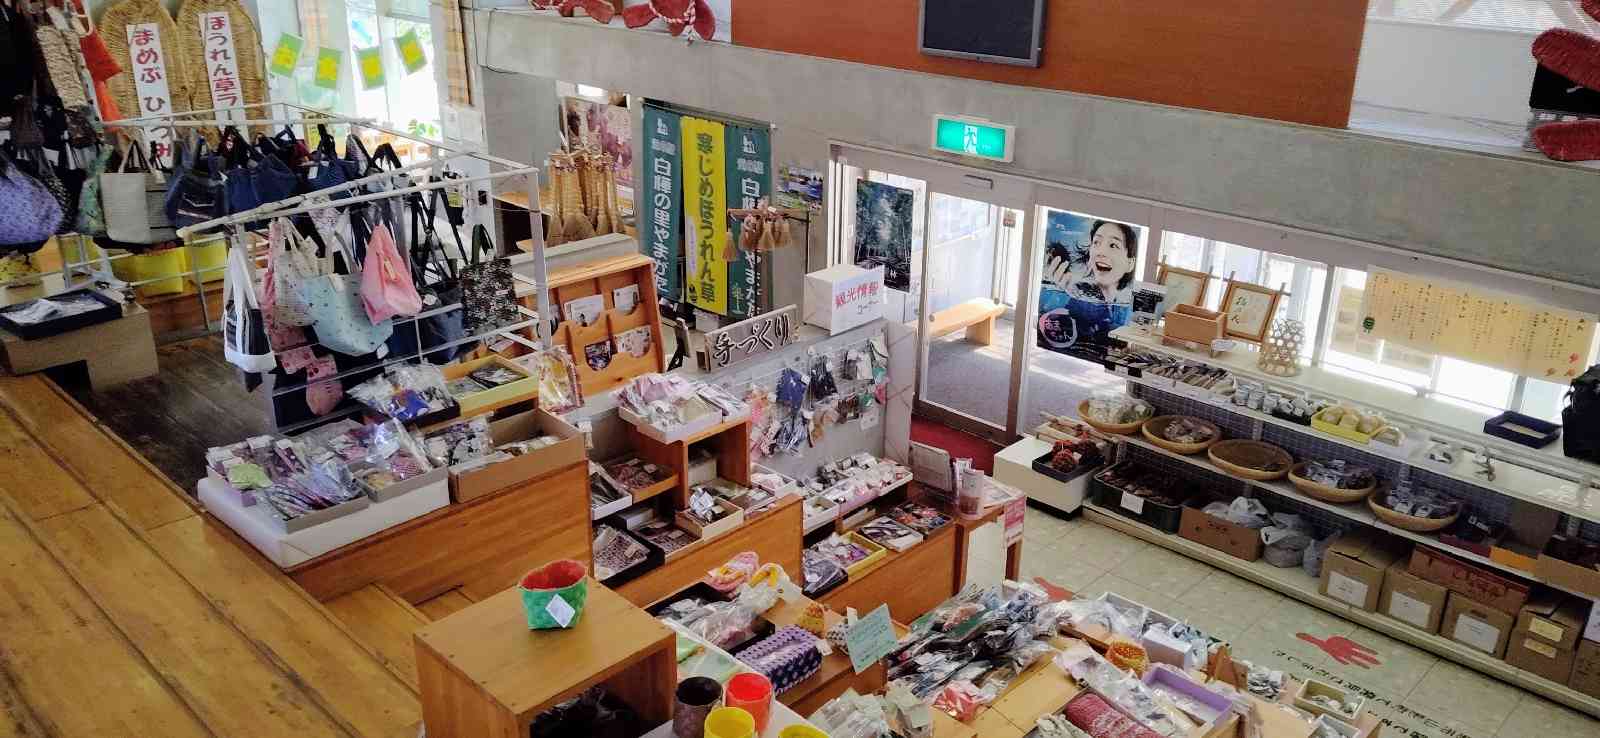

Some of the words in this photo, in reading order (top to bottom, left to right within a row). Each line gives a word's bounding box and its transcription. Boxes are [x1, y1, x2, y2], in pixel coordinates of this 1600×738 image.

[133, 29, 163, 84] まめぶ
[697, 132, 715, 303] 寒じめほうれん草
[713, 313, 790, 367] 手づくり
